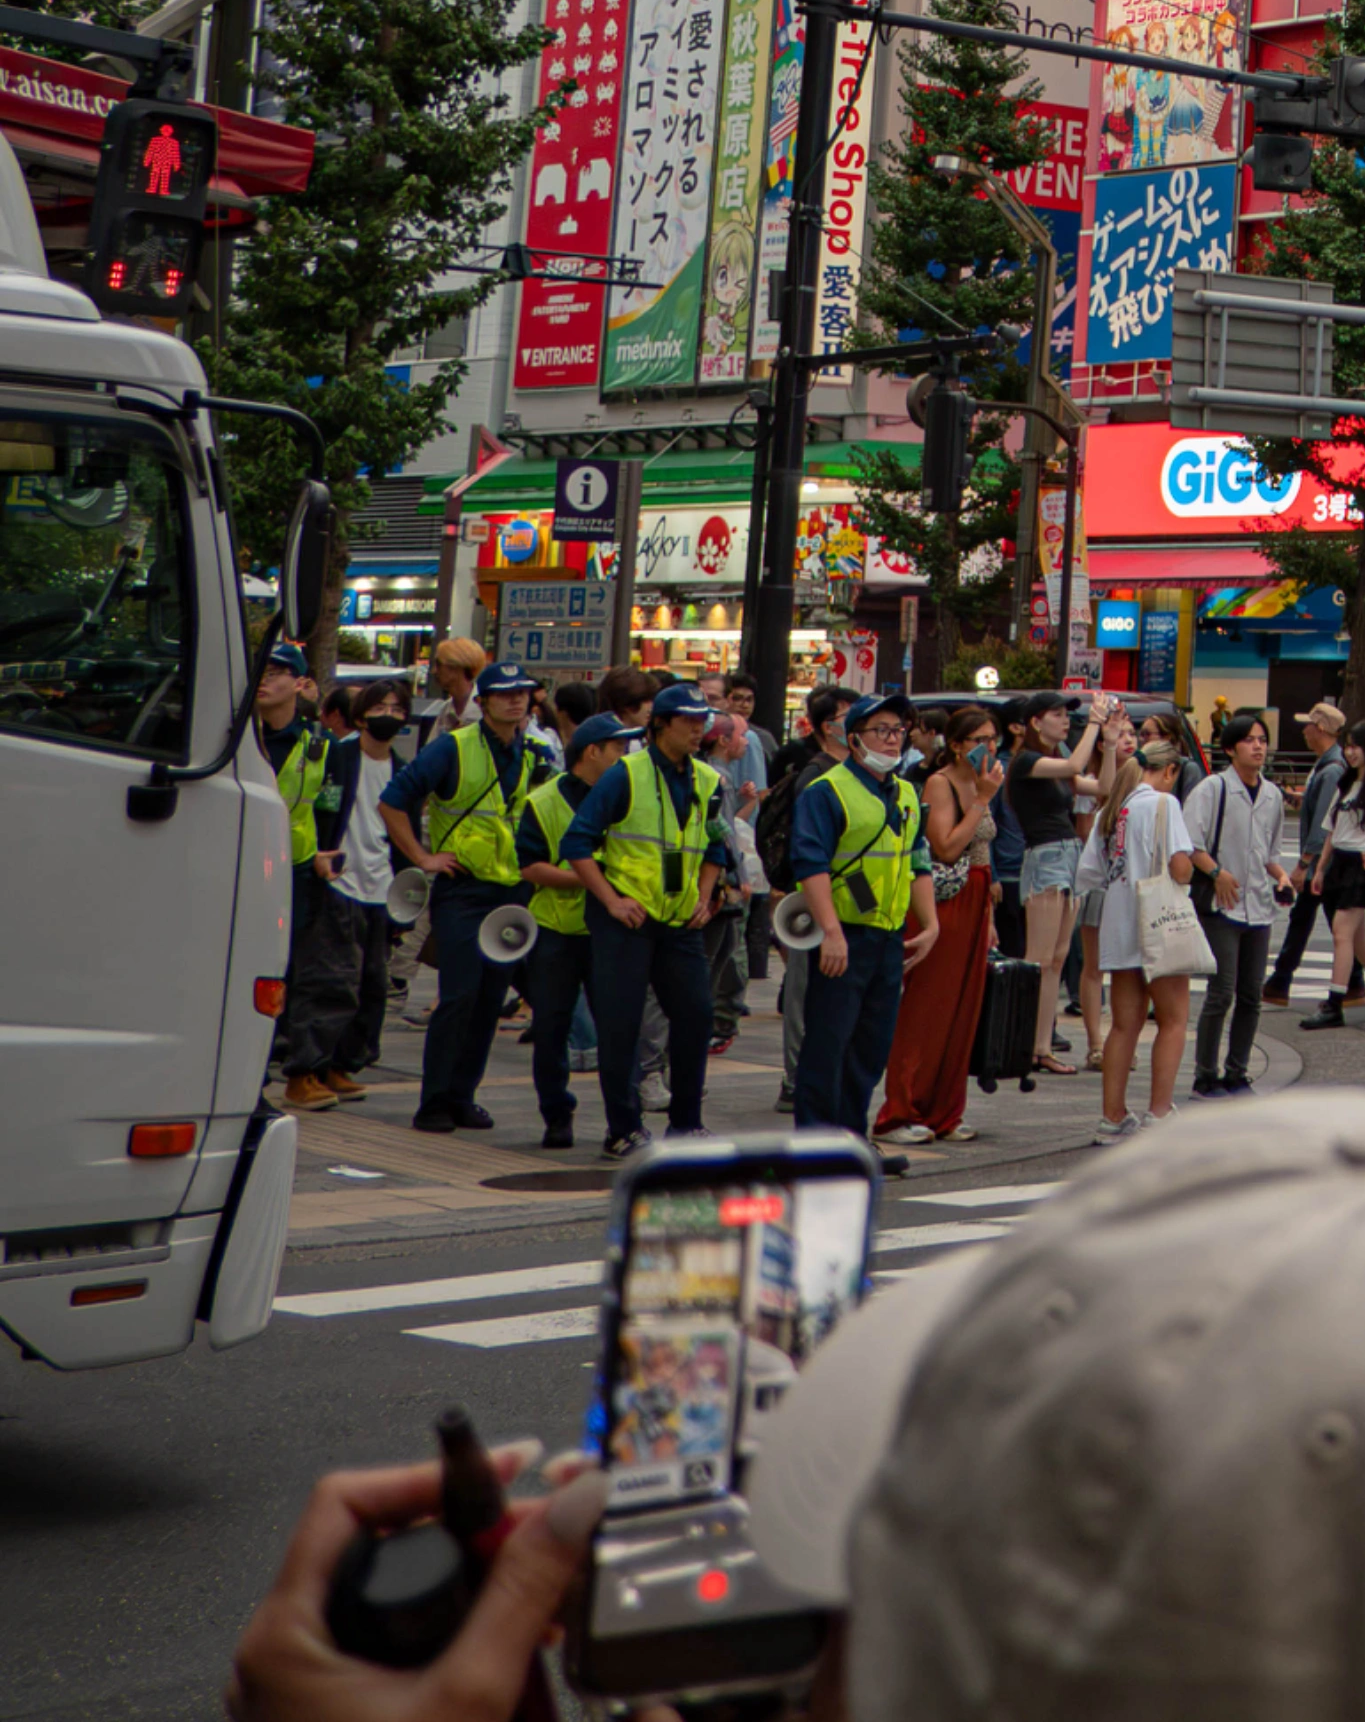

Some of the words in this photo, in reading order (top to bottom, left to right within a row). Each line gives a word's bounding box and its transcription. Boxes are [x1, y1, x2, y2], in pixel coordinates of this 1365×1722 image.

[827, 140, 866, 256] Shop
[1092, 167, 1199, 263] ゲームの
[1088, 186, 1221, 319] オアシスに
[531, 344, 595, 368] ENTRANCE
